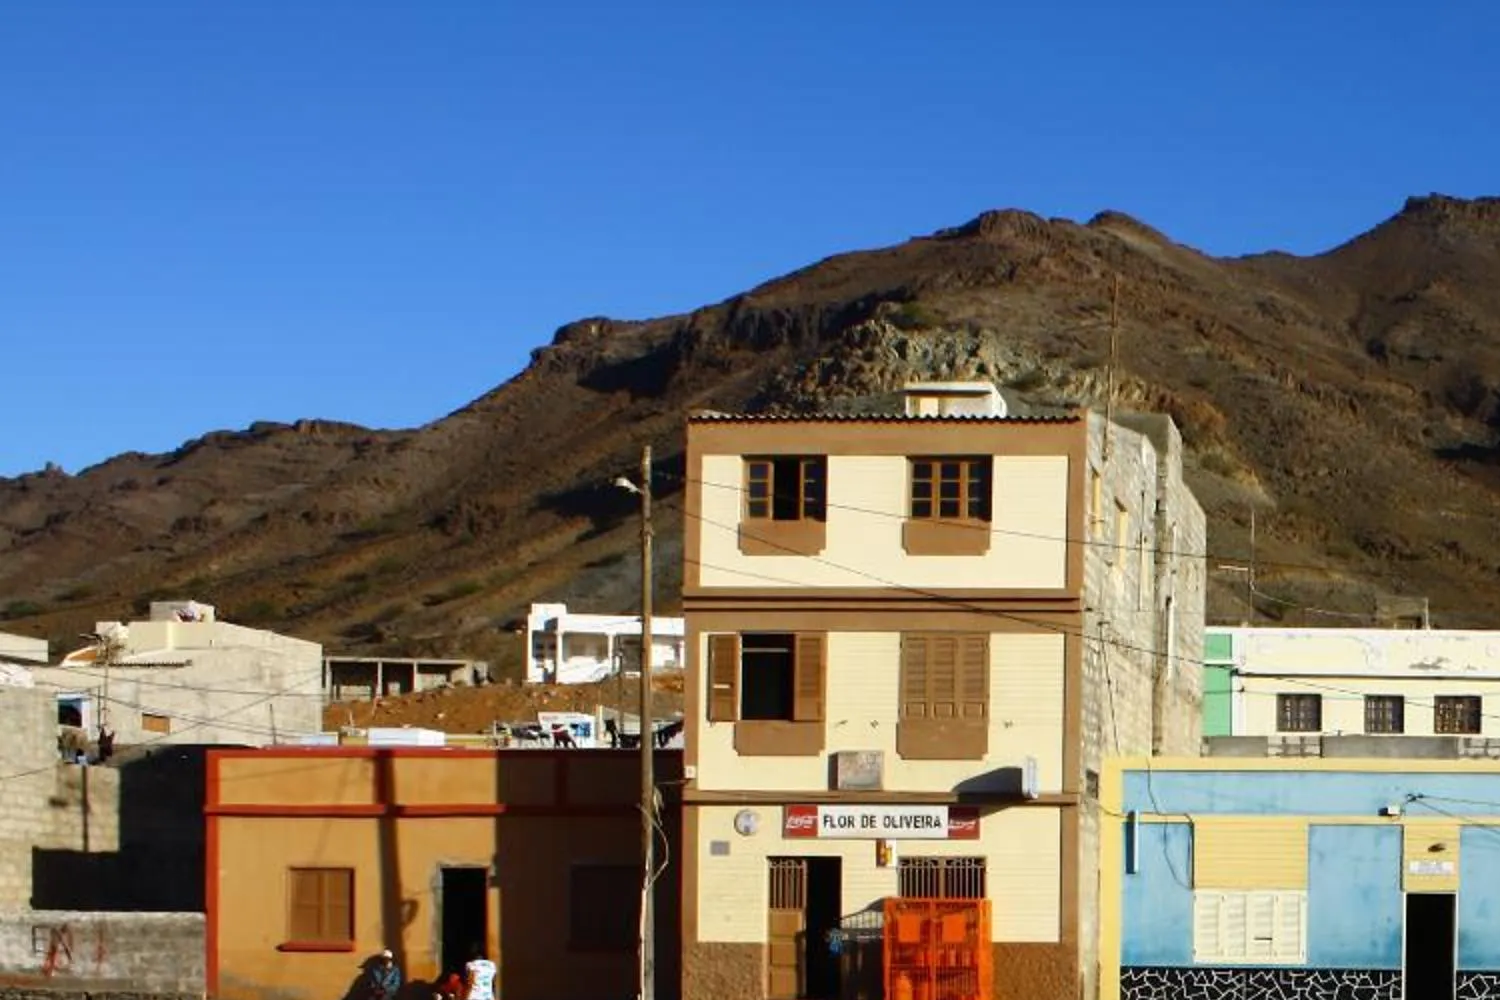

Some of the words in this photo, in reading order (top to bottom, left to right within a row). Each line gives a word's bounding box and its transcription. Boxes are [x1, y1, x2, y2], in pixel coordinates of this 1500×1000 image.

[823, 814, 855, 829] FLOR
[860, 814, 876, 829] DE
[882, 814, 942, 829] OLIVEIRA
